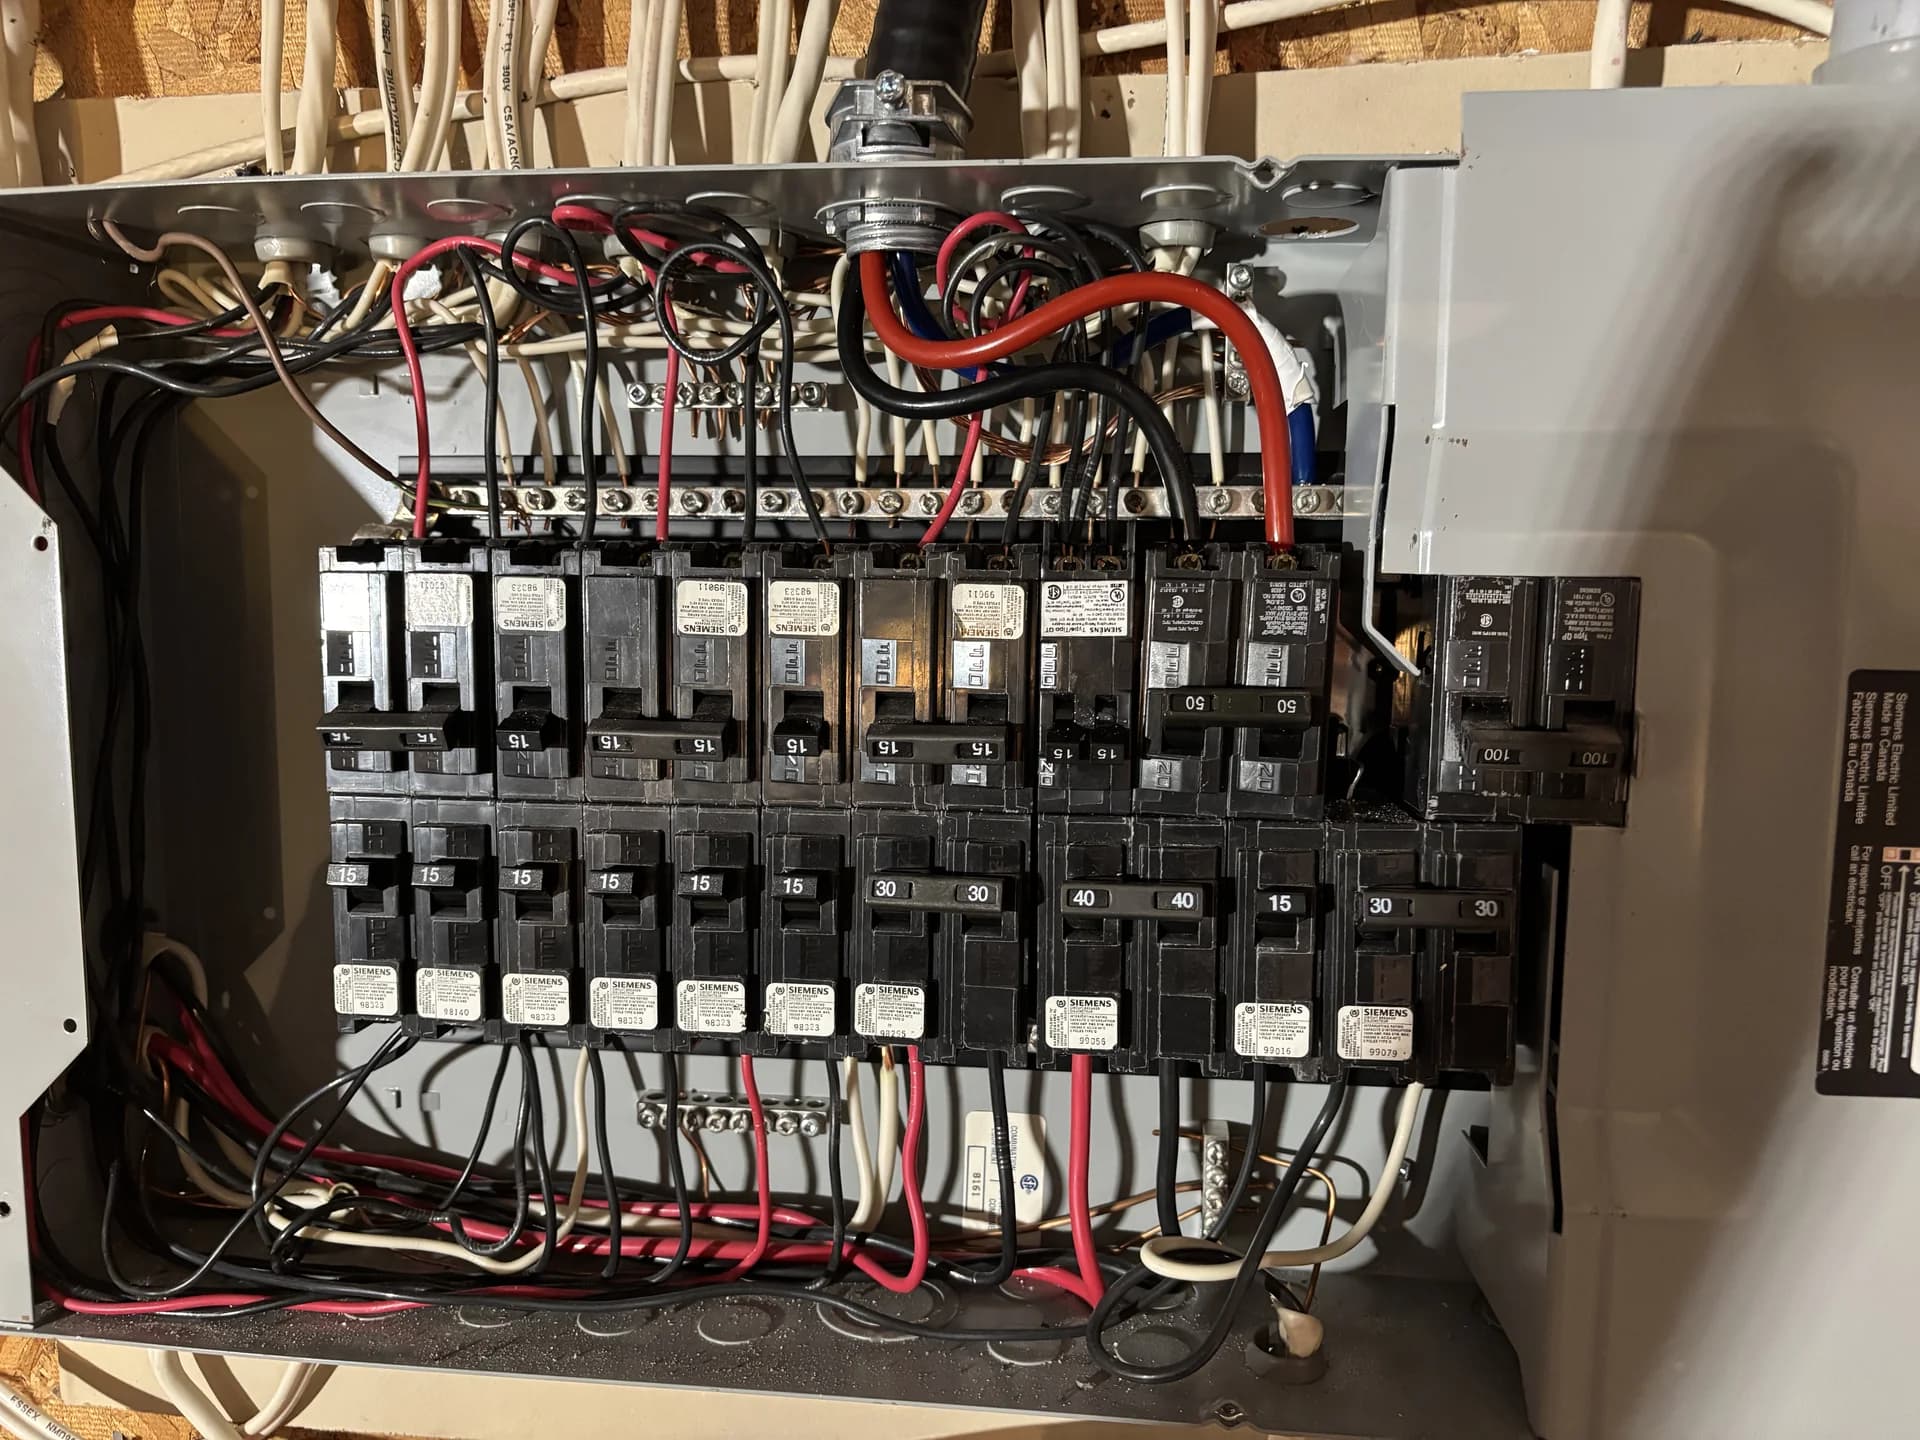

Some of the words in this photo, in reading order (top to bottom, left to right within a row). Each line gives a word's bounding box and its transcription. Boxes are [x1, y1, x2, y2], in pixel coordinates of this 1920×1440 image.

[504, 620, 543, 628] SIEMENS
[684, 625, 724, 633] SIEMENS
[776, 624, 816, 632] SIEMENS
[1185, 696, 1205, 710] 50
[1277, 698, 1296, 713] 50
[1881, 692, 1893, 723] Made
[1849, 691, 1864, 740] Fabriqué
[1862, 692, 1877, 740] Siemens
[1893, 692, 1908, 741] Siemens
[1880, 726, 1891, 736] in
[509, 734, 530, 749] 15
[601, 735, 621, 749] 15
[694, 739, 715, 753] 15
[786, 738, 808, 754] 15
[878, 741, 899, 755] 15
[972, 743, 993, 756] 15
[1848, 743, 1859, 757] au
[1053, 748, 1073, 759] 15
[1098, 748, 1117, 759] 15
[1484, 748, 1510, 762] 100
[1583, 752, 1609, 765] 100
[1876, 739, 1890, 782] Canada
[1859, 743, 1873, 783] Electric
[1889, 743, 1904, 784] Electric
[1844, 759, 1859, 802] Canada
[1855, 785, 1870, 825] Limitée
[1885, 786, 1901, 826] Limited
[1850, 845, 1861, 861] call
[1861, 845, 1873, 861] For
[337, 866, 357, 883] 15
[420, 865, 440, 882] 15
[511, 869, 532, 886] 15
[1849, 863, 1858, 875] an
[599, 873, 620, 889] 15
[691, 874, 710, 891] 15
[783, 878, 803, 894] 15
[1858, 864, 1870, 894] repairs
[1880, 865, 1893, 891] OFF
[876, 880, 896, 896] 30
[967, 885, 988, 901] 30
[1072, 890, 1095, 906] 40
[1171, 892, 1194, 908] 40
[1268, 895, 1292, 912] 15
[1370, 897, 1392, 914] 30
[1474, 900, 1498, 917] 30
[1844, 877, 1857, 925] electrician.
[1858, 897, 1867, 906] or
[1853, 909, 1866, 955] alterations
[354, 967, 391, 976] SIEMENS
[437, 969, 474, 978] SIEMENS
[1837, 966, 1848, 987] pour
[524, 977, 563, 986] SIEMENS
[613, 981, 651, 989] SIEMENS
[699, 983, 739, 992] SIEMENS
[1848, 966, 1862, 1009] Consulter
[789, 986, 829, 995] SIEMENS
[879, 986, 919, 996] SIEMENS
[1825, 965, 1838, 1021] modification.
[1070, 999, 1112, 1007] SIEMENS
[1837, 988, 1848, 1011] toute
[1259, 1005, 1303, 1014] SIEMENS
[1364, 1008, 1408, 1017] SIEMENS
[1846, 1011, 1857, 1023] un
[1833, 1013, 1846, 1057] réparation
[1370, 1048, 1398, 1057] 99079
[1843, 1025, 1857, 1069] électricien
[1831, 1059, 1841, 1071] ou
